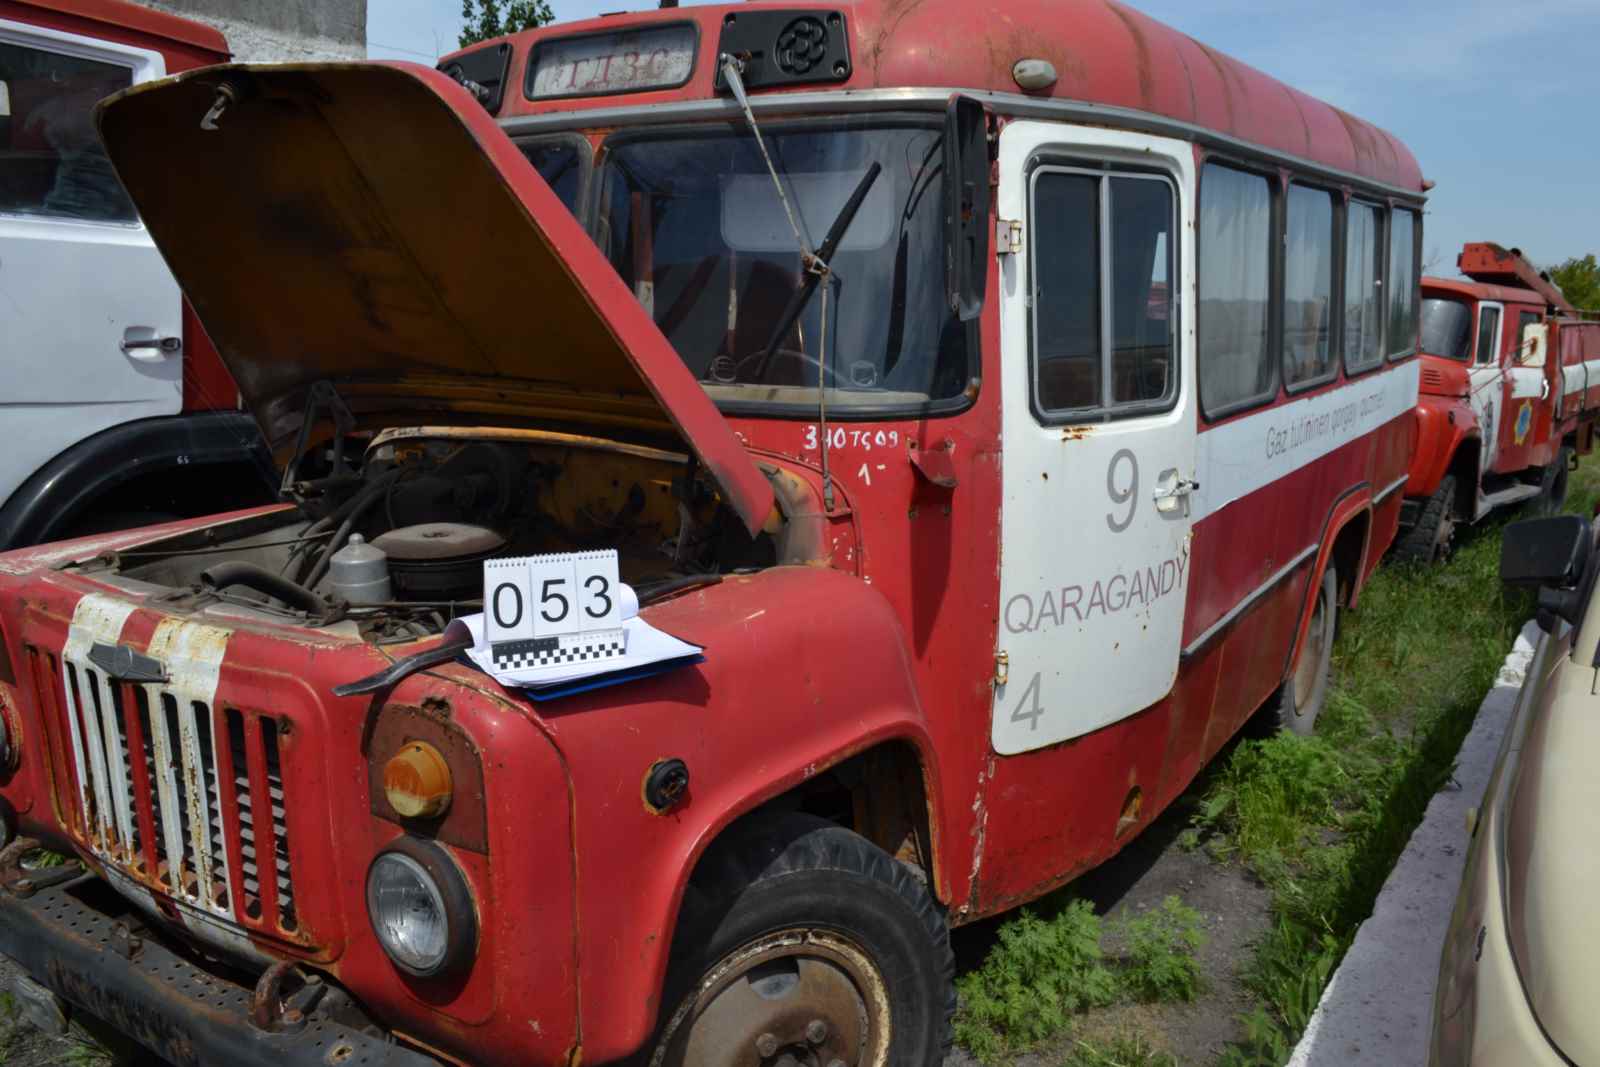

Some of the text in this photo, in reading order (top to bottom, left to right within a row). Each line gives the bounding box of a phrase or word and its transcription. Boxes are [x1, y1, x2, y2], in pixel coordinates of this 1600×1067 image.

[1266, 426, 1288, 459] Gaz
[1106, 448, 1140, 534] 9
[492, 575, 612, 629] 053
[1004, 556, 1188, 634] QARAGANDY
[1010, 671, 1045, 731] 4
